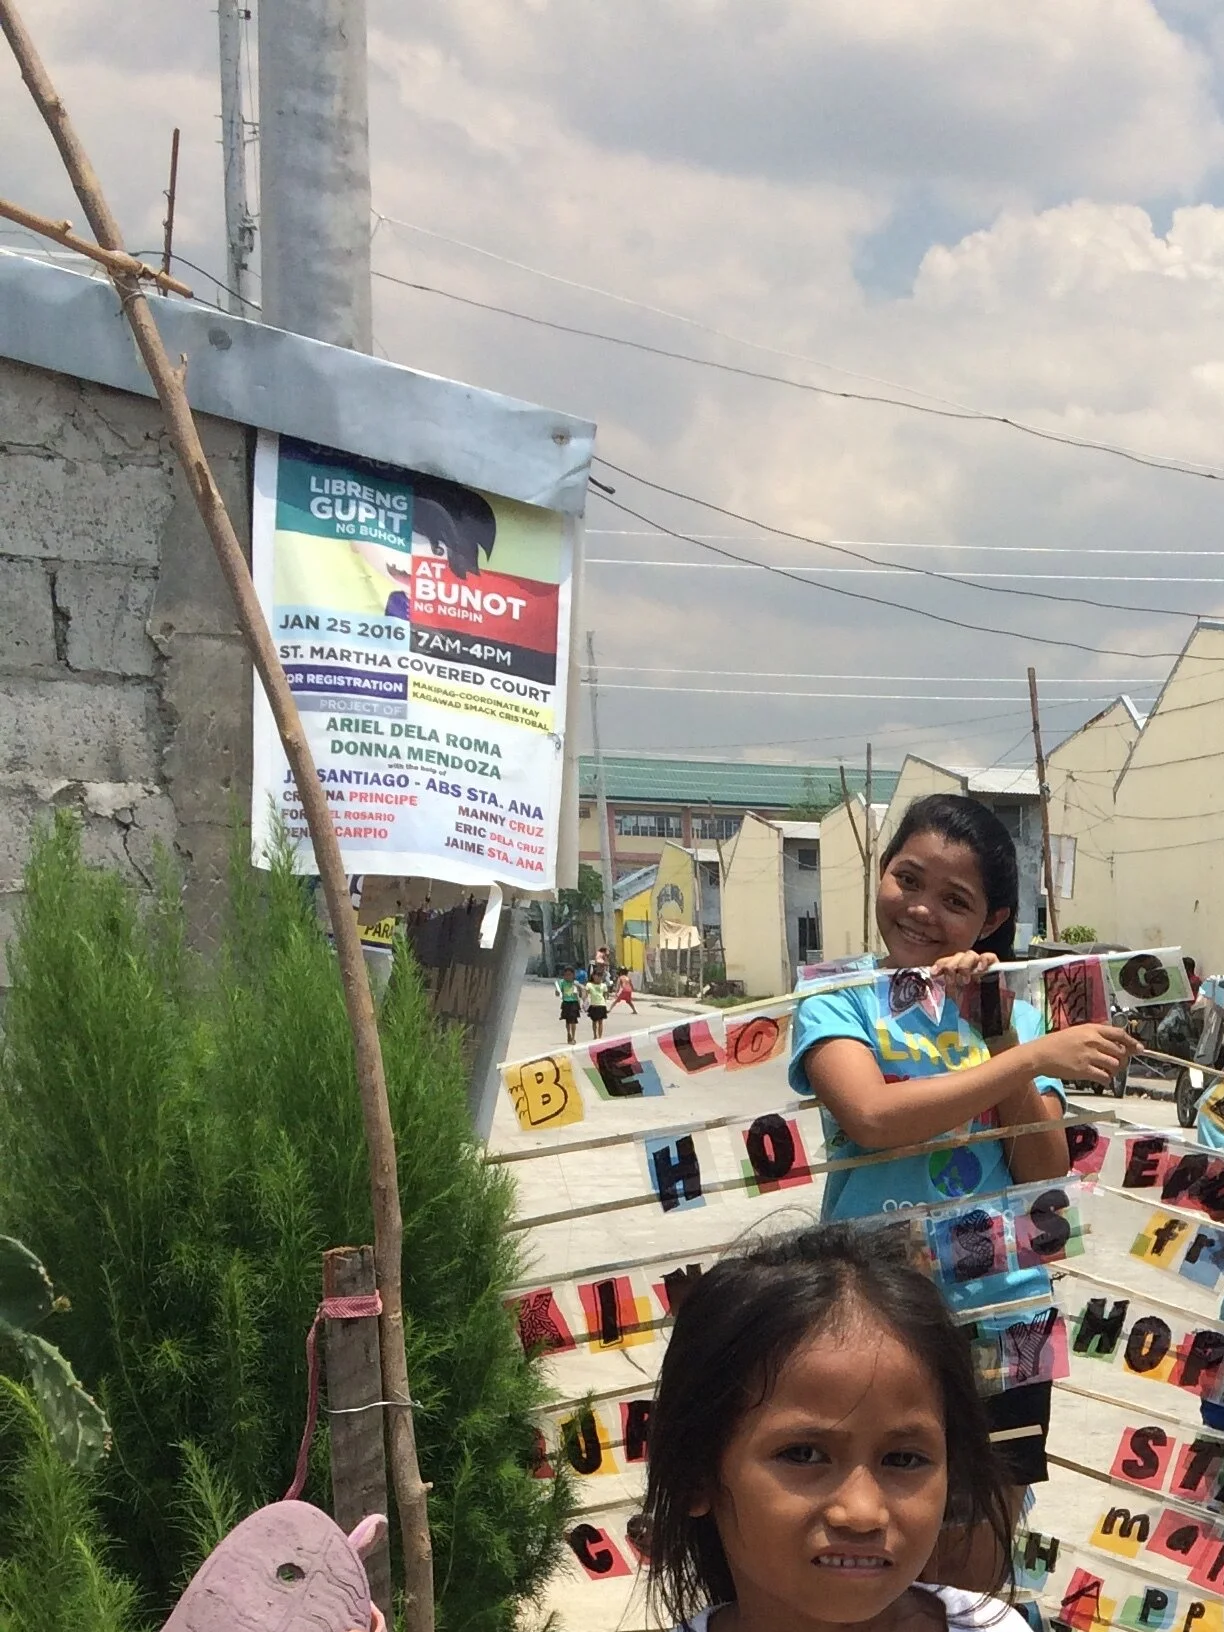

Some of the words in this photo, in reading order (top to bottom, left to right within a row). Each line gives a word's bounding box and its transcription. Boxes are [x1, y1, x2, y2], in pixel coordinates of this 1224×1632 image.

[310, 476, 408, 511] LIBRENG
[309, 496, 407, 534] GUPIT
[336, 523, 356, 534] NG
[360, 525, 406, 547] BUHOK
[416, 561, 446, 579] AT
[414, 601, 434, 614] NG
[437, 604, 483, 623] NGIPIN
[415, 578, 527, 620] BUNOT
[279, 614, 319, 630] JAN
[326, 618, 351, 634] 25
[357, 622, 406, 641] 2016
[417, 631, 512, 667] 7AM-4PM
[280, 645, 304, 658] ST.
[310, 646, 391, 668] MARTHA
[397, 656, 485, 685] COVERED
[490, 677, 551, 703] COURT
[285, 674, 303, 684] OR
[306, 674, 403, 692] REGISTRATION
[320, 699, 379, 713] PROJECT
[383, 705, 402, 715] OF
[412, 691, 461, 709] KAGAWAD
[463, 703, 497, 717] SMACK
[498, 711, 550, 731] CRISTOBAL
[521, 707, 540, 718] KAY
[326, 717, 385, 736] ARIEL
[390, 723, 440, 743] DELA
[445, 733, 503, 758] ROMA
[331, 739, 402, 760] DONNA
[407, 746, 502, 780] MENDOZA
[405, 763, 419, 771] the
[316, 768, 410, 788] SANTIAGO
[425, 777, 462, 798] ABS
[467, 787, 504, 809] STA.
[508, 799, 544, 821] ANA
[349, 791, 418, 806] PRINCIPE
[335, 826, 388, 839] CARPIO
[344, 810, 395, 822] ROSARIO
[458, 805, 506, 827] MANNY
[508, 819, 544, 838] CRUZ
[444, 836, 485, 856] JAIME
[487, 847, 514, 865] STA.
[515, 856, 544, 872] ANA
[455, 821, 487, 839] ERIC
[489, 832, 515, 848] DELA
[516, 841, 545, 855] CRUZ
